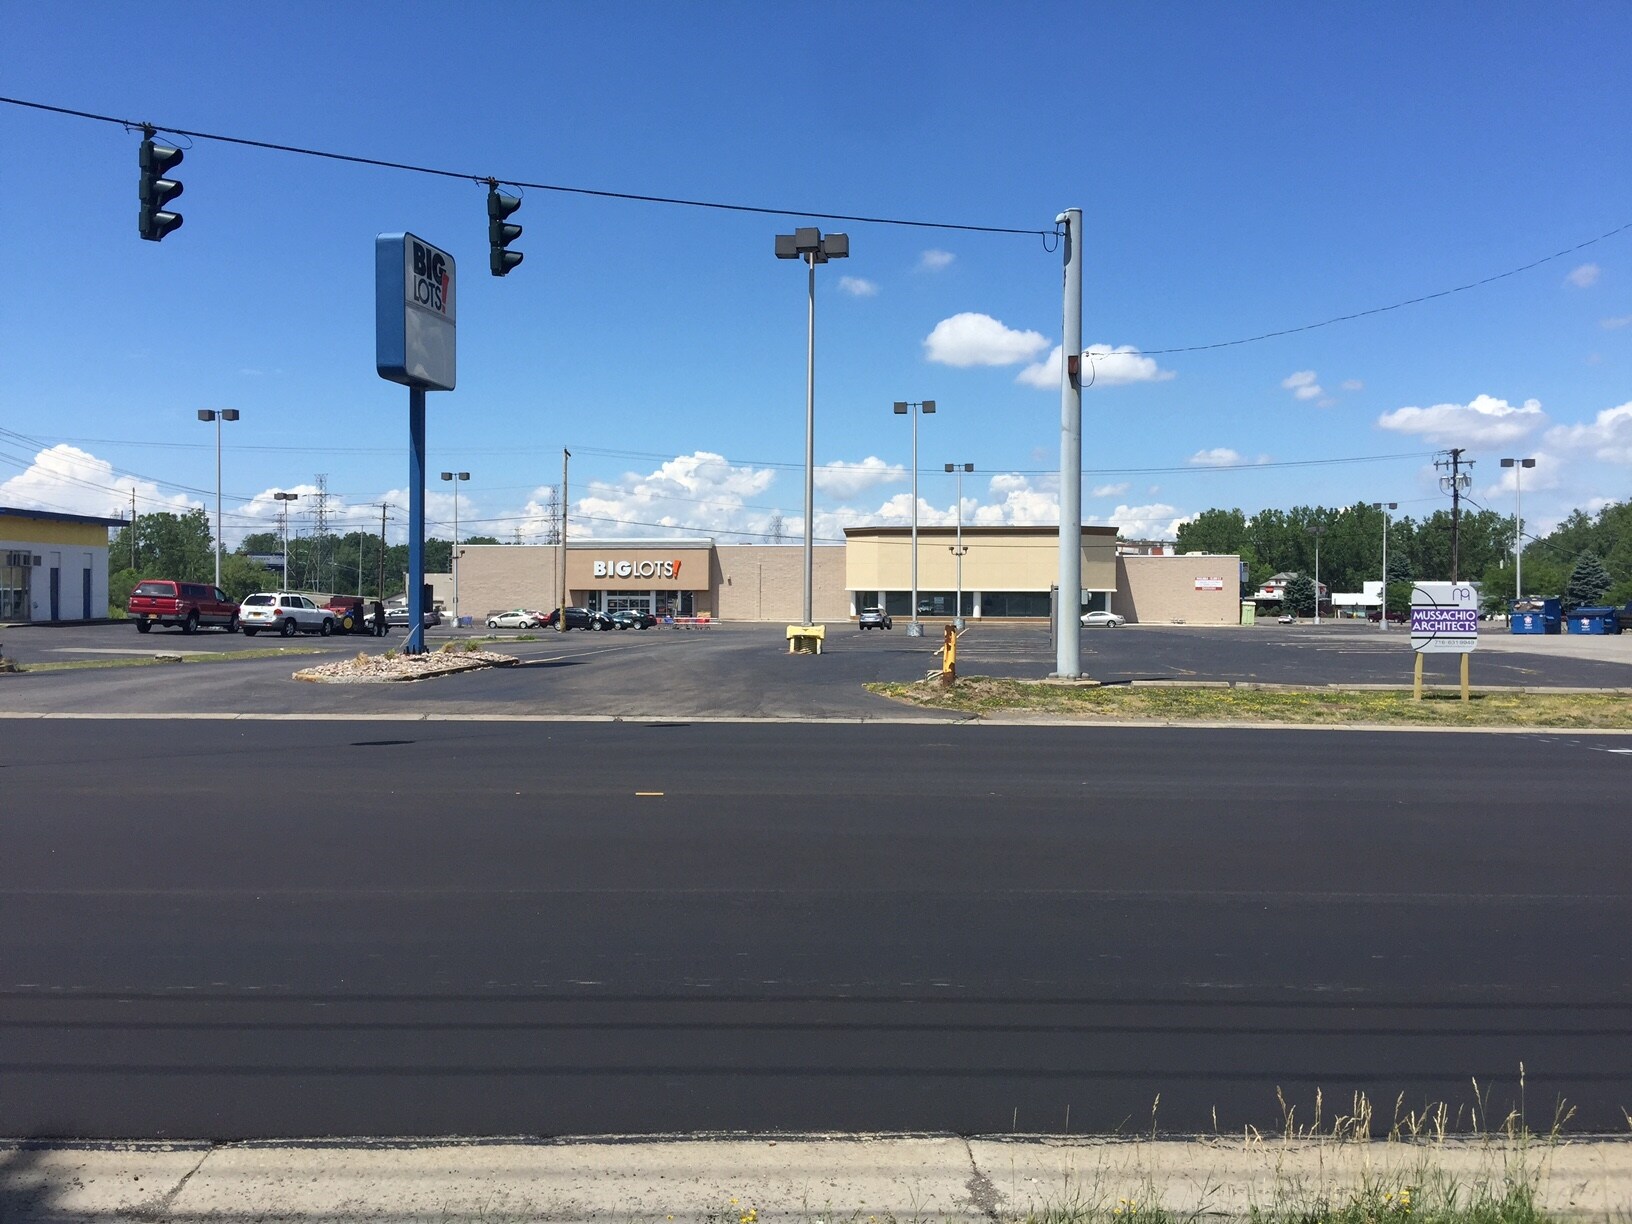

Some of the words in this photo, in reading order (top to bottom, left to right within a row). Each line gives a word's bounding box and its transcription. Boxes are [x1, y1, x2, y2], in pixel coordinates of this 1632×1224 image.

[412, 240, 446, 286] BIG
[413, 272, 450, 315] LOTS!
[1412, 621, 1477, 631] ARCHITECTS
[1413, 611, 1476, 621] MUSSACHIO
